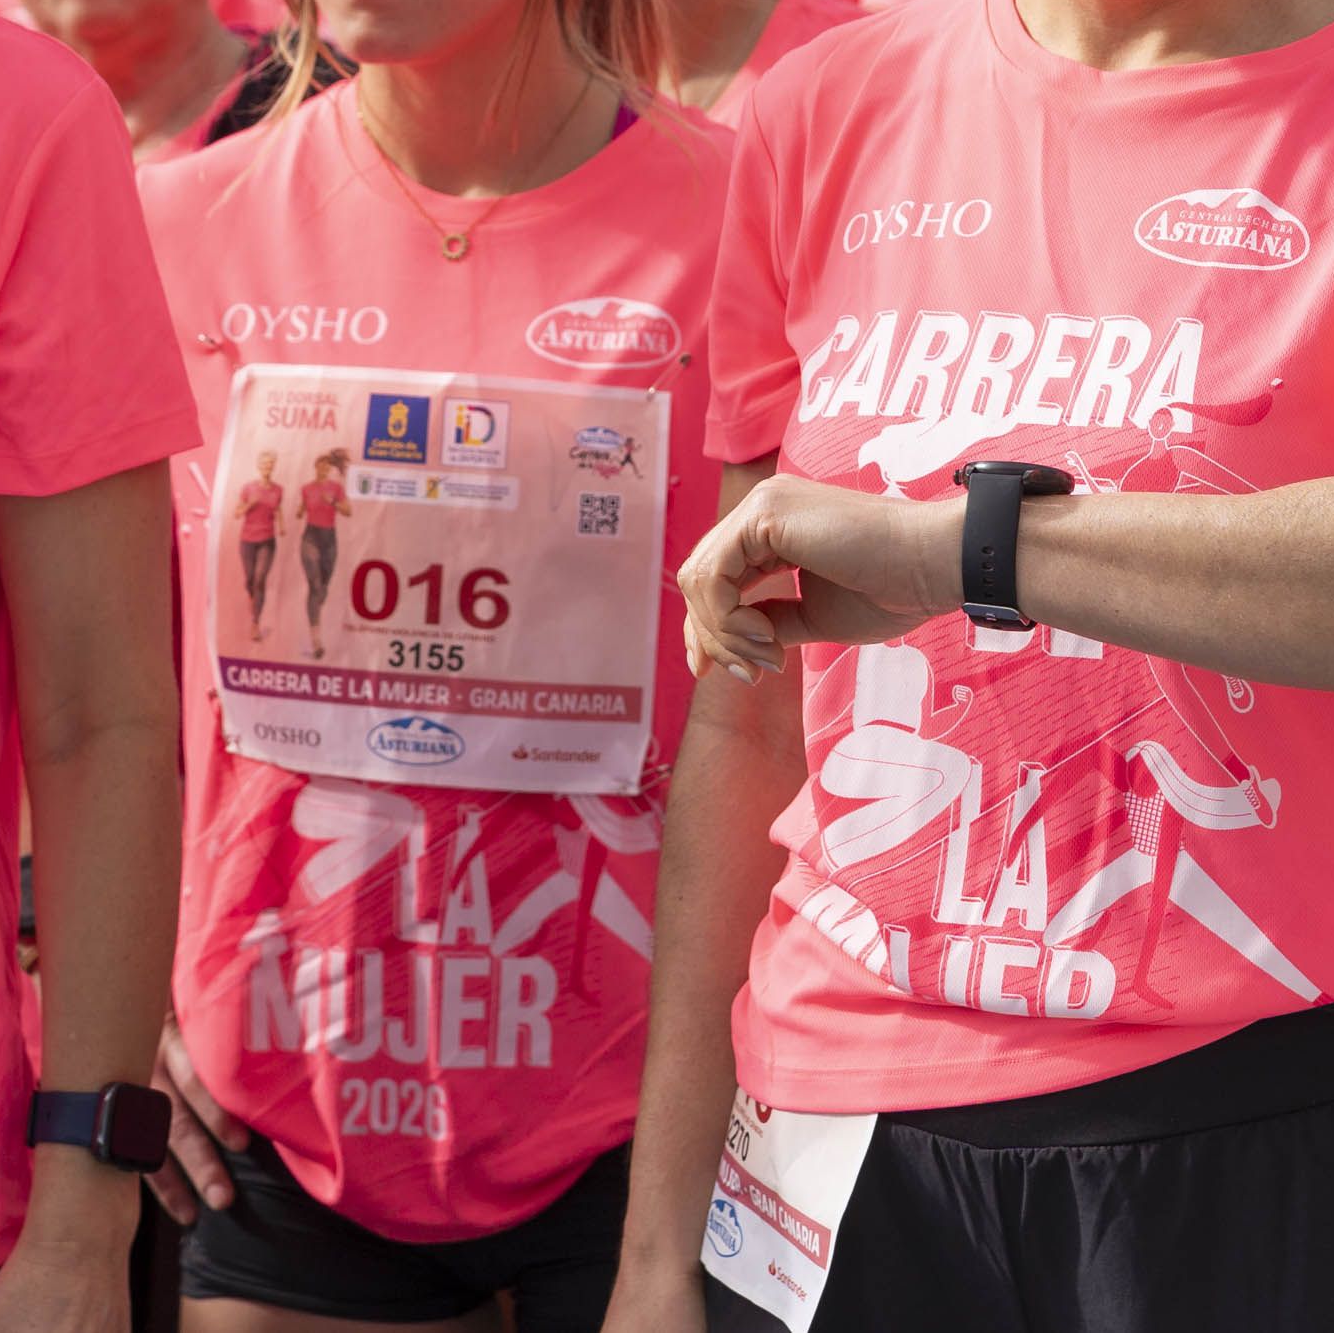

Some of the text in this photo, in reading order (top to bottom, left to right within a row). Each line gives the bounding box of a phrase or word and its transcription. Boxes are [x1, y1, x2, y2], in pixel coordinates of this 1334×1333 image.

[843, 198, 993, 254] OYSHO
[1144, 209, 1293, 260] ASTURIANA
[1179, 209, 1294, 235] CENTRAL LECHERA
[222, 303, 388, 344] OYSHO
[537, 319, 668, 355] ASTURIANA
[797, 309, 1204, 433] CARRERA
[265, 406, 338, 432] SUMA
[350, 559, 511, 631] 016
[388, 640, 465, 671] 3155
[226, 665, 627, 715] CARRERA DE LA MUJER GRAN CANARIA
[253, 721, 322, 748] OYSHO
[375, 733, 458, 756] ASTURIANA
[531, 748, 602, 763] Santander
[932, 757, 1050, 932] LA
[394, 802, 494, 947] LA
[243, 942, 560, 1070] MUJER
[341, 1078, 448, 1141] 2026
[726, 1114, 751, 1162] 270
[778, 1205, 821, 1258] CANARIA
